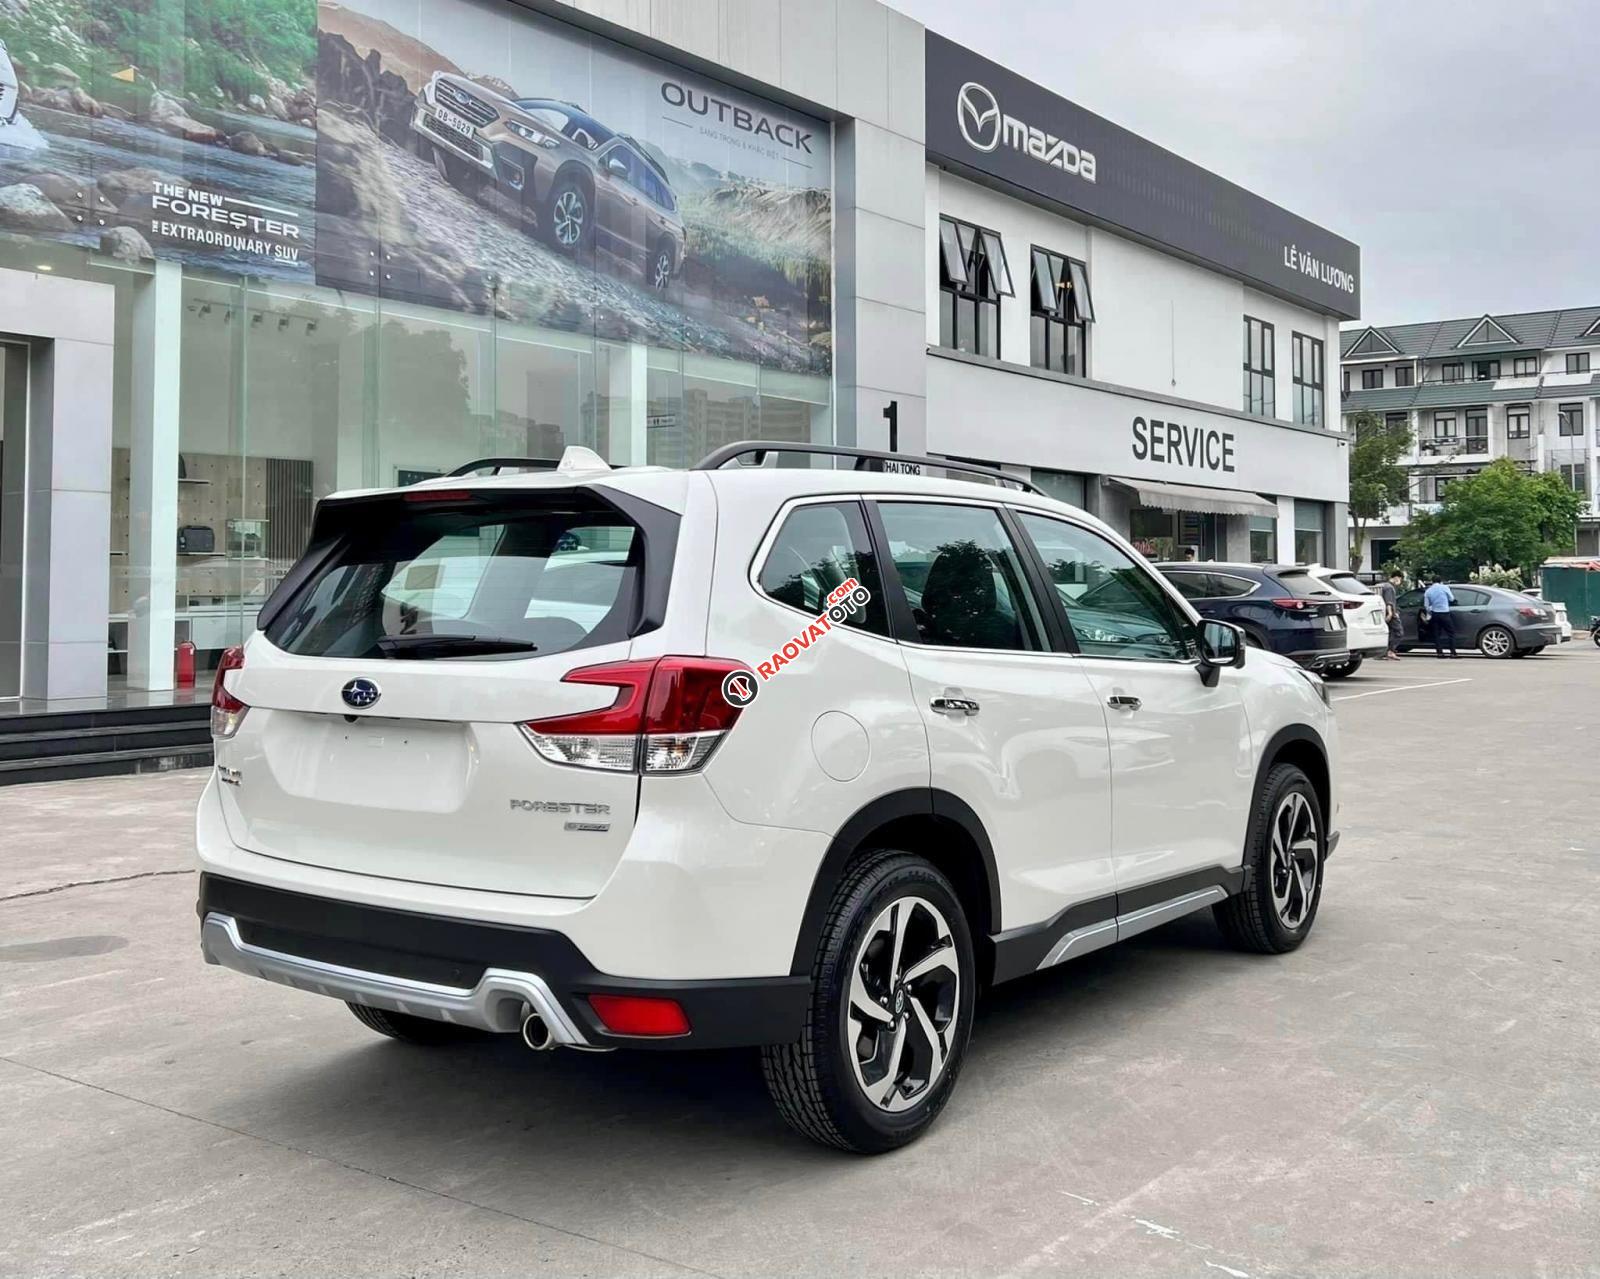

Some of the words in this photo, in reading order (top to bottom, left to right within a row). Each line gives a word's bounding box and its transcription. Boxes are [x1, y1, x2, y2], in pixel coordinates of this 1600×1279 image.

[661, 82, 813, 154] OUTBACK
[1003, 114, 1097, 184] mazda
[152, 181, 184, 199] THE
[188, 189, 223, 207] NEW
[152, 195, 300, 239] FORESTER
[161, 221, 271, 255] EXTRAORDINARY
[275, 244, 299, 261] SUV
[1284, 244, 1297, 270] LÊ
[1299, 250, 1319, 279] VĂN
[883, 400, 897, 452] 1
[1132, 416, 1235, 472] SERVICE
[510, 799, 610, 814] FORESTER
